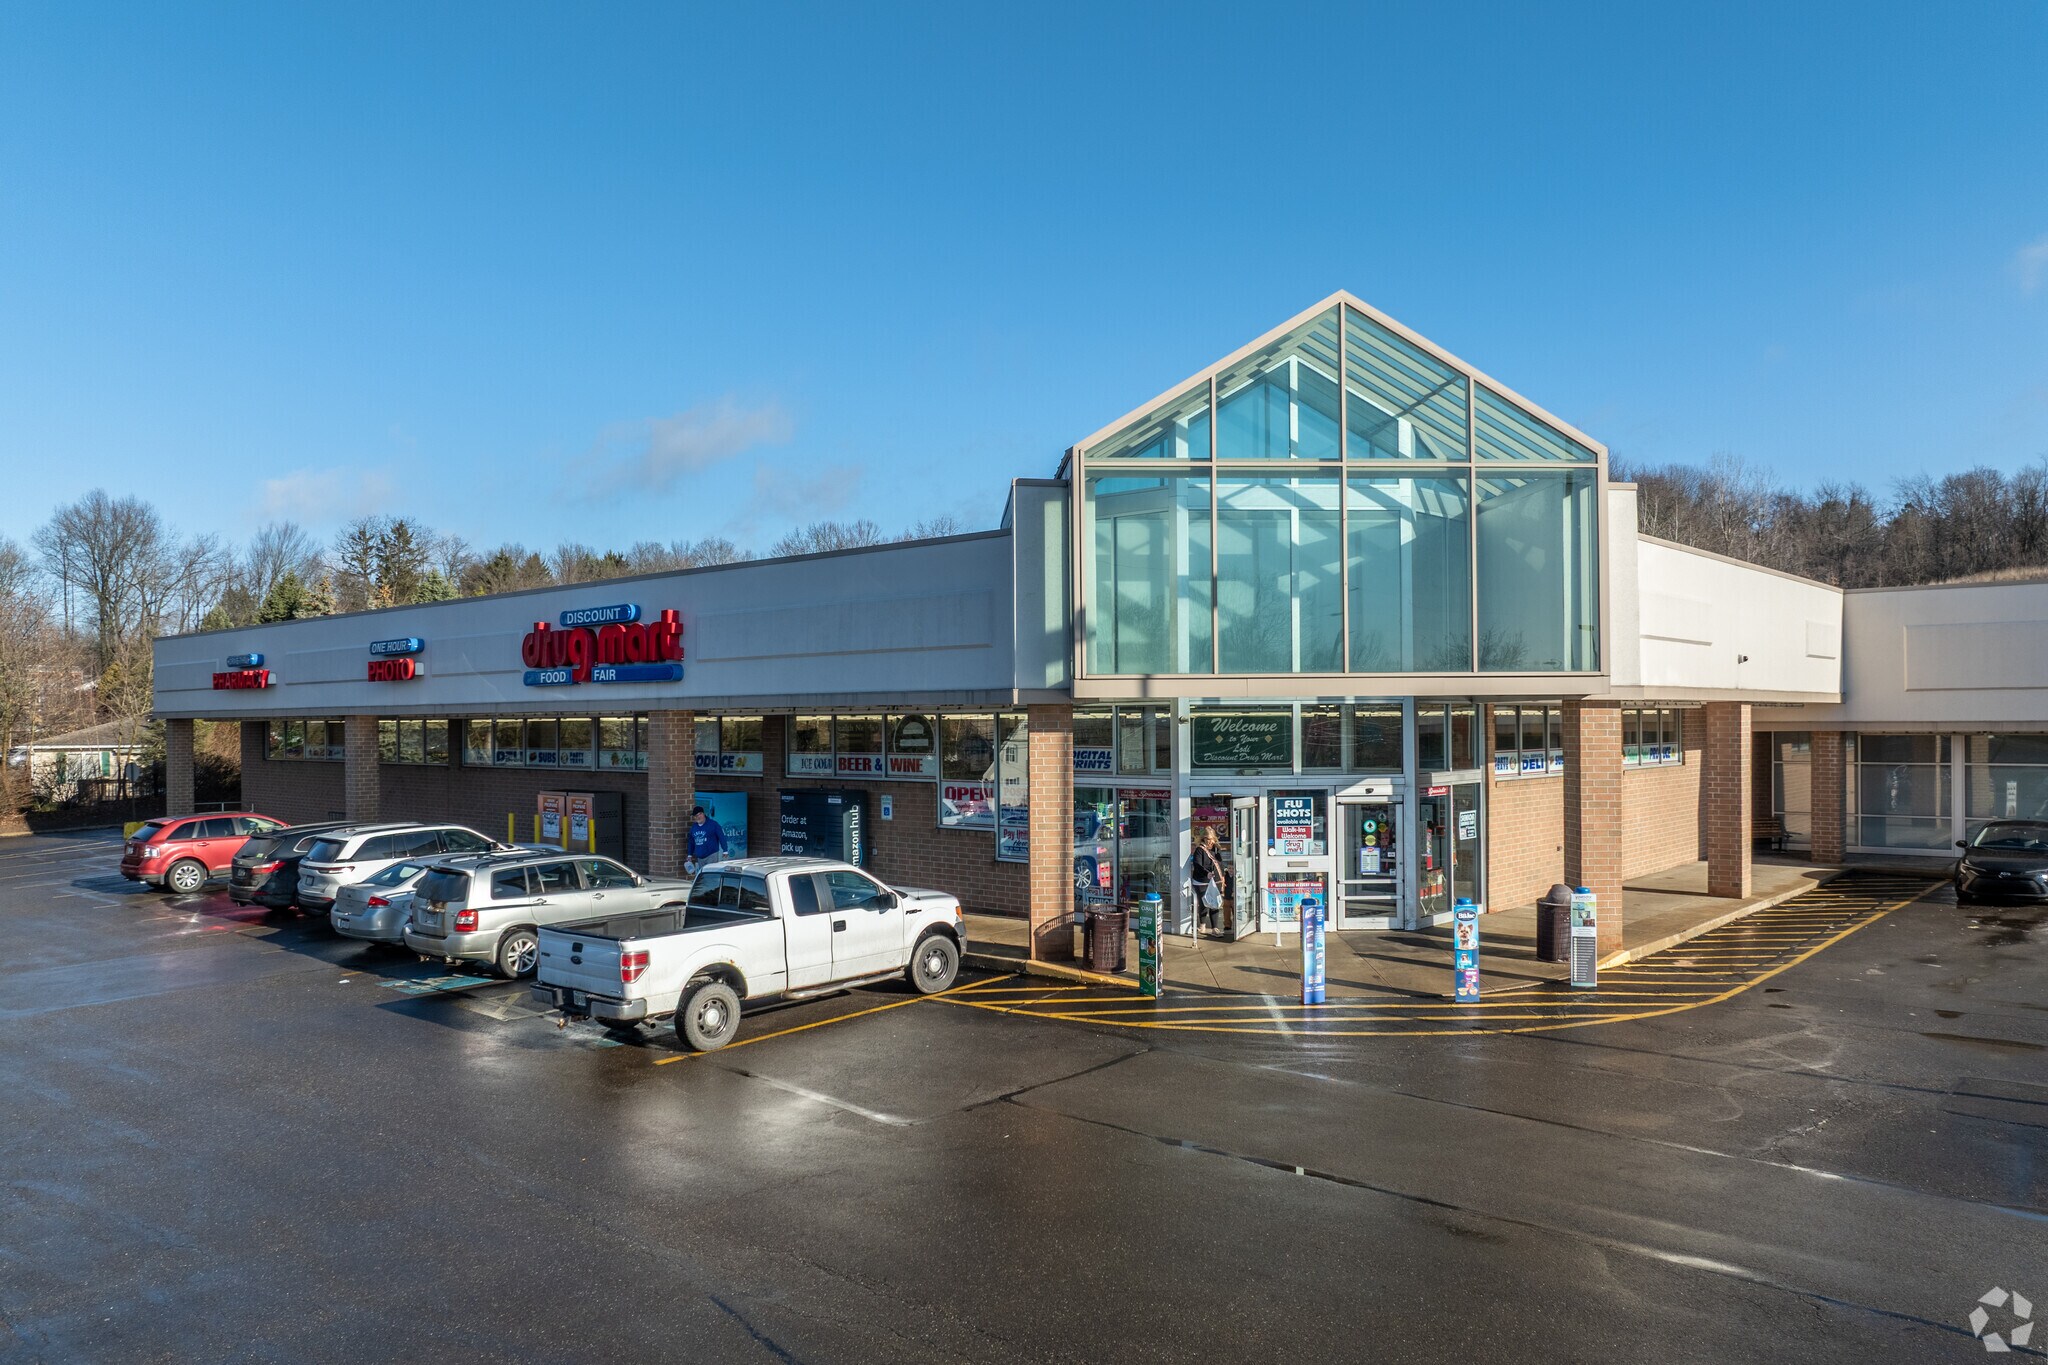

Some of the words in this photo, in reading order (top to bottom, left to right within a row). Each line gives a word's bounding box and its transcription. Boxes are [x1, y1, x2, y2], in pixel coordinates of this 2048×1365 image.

[566, 608, 621, 624] DISCOUNT
[371, 643, 387, 654] ONE
[387, 640, 407, 652] HOUR
[522, 621, 597, 683] drug
[598, 609, 685, 664] mart
[368, 658, 415, 682] PHOTO
[540, 671, 567, 684] FOOD
[593, 669, 617, 681] FAIR
[212, 669, 271, 690] PHARMACY
[1211, 717, 1278, 732] Welcome
[1240, 734, 1259, 744] Your
[1232, 743, 1251, 753] Lodi
[538, 752, 557, 764] SUBS
[694, 755, 735, 768] ODUCE
[1204, 752, 1239, 761] Discount
[1239, 752, 1260, 763] Drug
[1261, 752, 1284, 761] Mart
[1522, 758, 1544, 770] DELI
[801, 758, 813, 769] ICE
[814, 758, 833, 770] COLD
[838, 757, 872, 772] BEER
[874, 758, 882, 771] &
[890, 758, 923, 773] WINE
[1284, 800, 1303, 808] FLU
[781, 814, 799, 824] Order
[799, 816, 807, 825] at
[849, 804, 860, 829] hub
[1276, 808, 1312, 818] SHOTS
[781, 828, 808, 841] Amazon,
[781, 842, 794, 853] pick
[794, 845, 804, 854] up
[851, 830, 860, 867] mazon
[1285, 840, 1301, 849] drug
[1283, 906, 1294, 914] OFF
